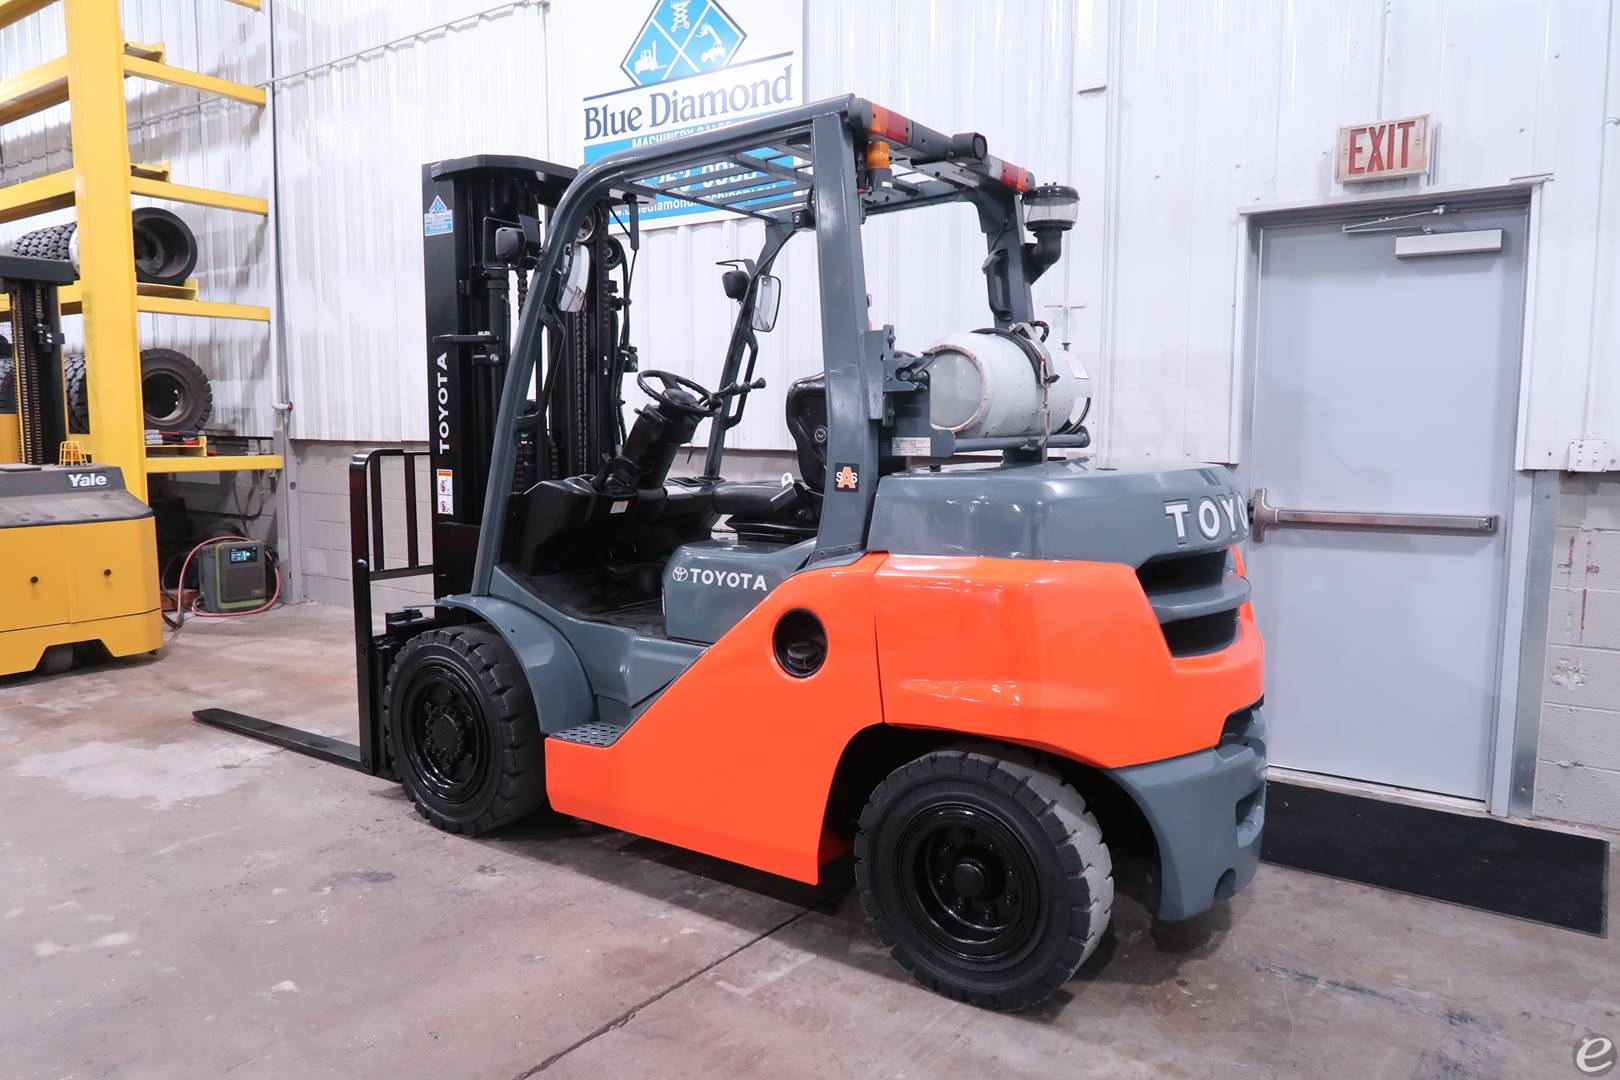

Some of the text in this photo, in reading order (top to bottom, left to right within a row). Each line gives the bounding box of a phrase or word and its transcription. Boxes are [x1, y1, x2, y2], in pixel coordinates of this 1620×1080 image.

[583, 64, 793, 141] Blue Diamond
[1348, 120, 1416, 175] EXIT
[436, 352, 450, 455] TOYOTA
[67, 473, 108, 488] Yale
[690, 567, 768, 592] TOYOTA
